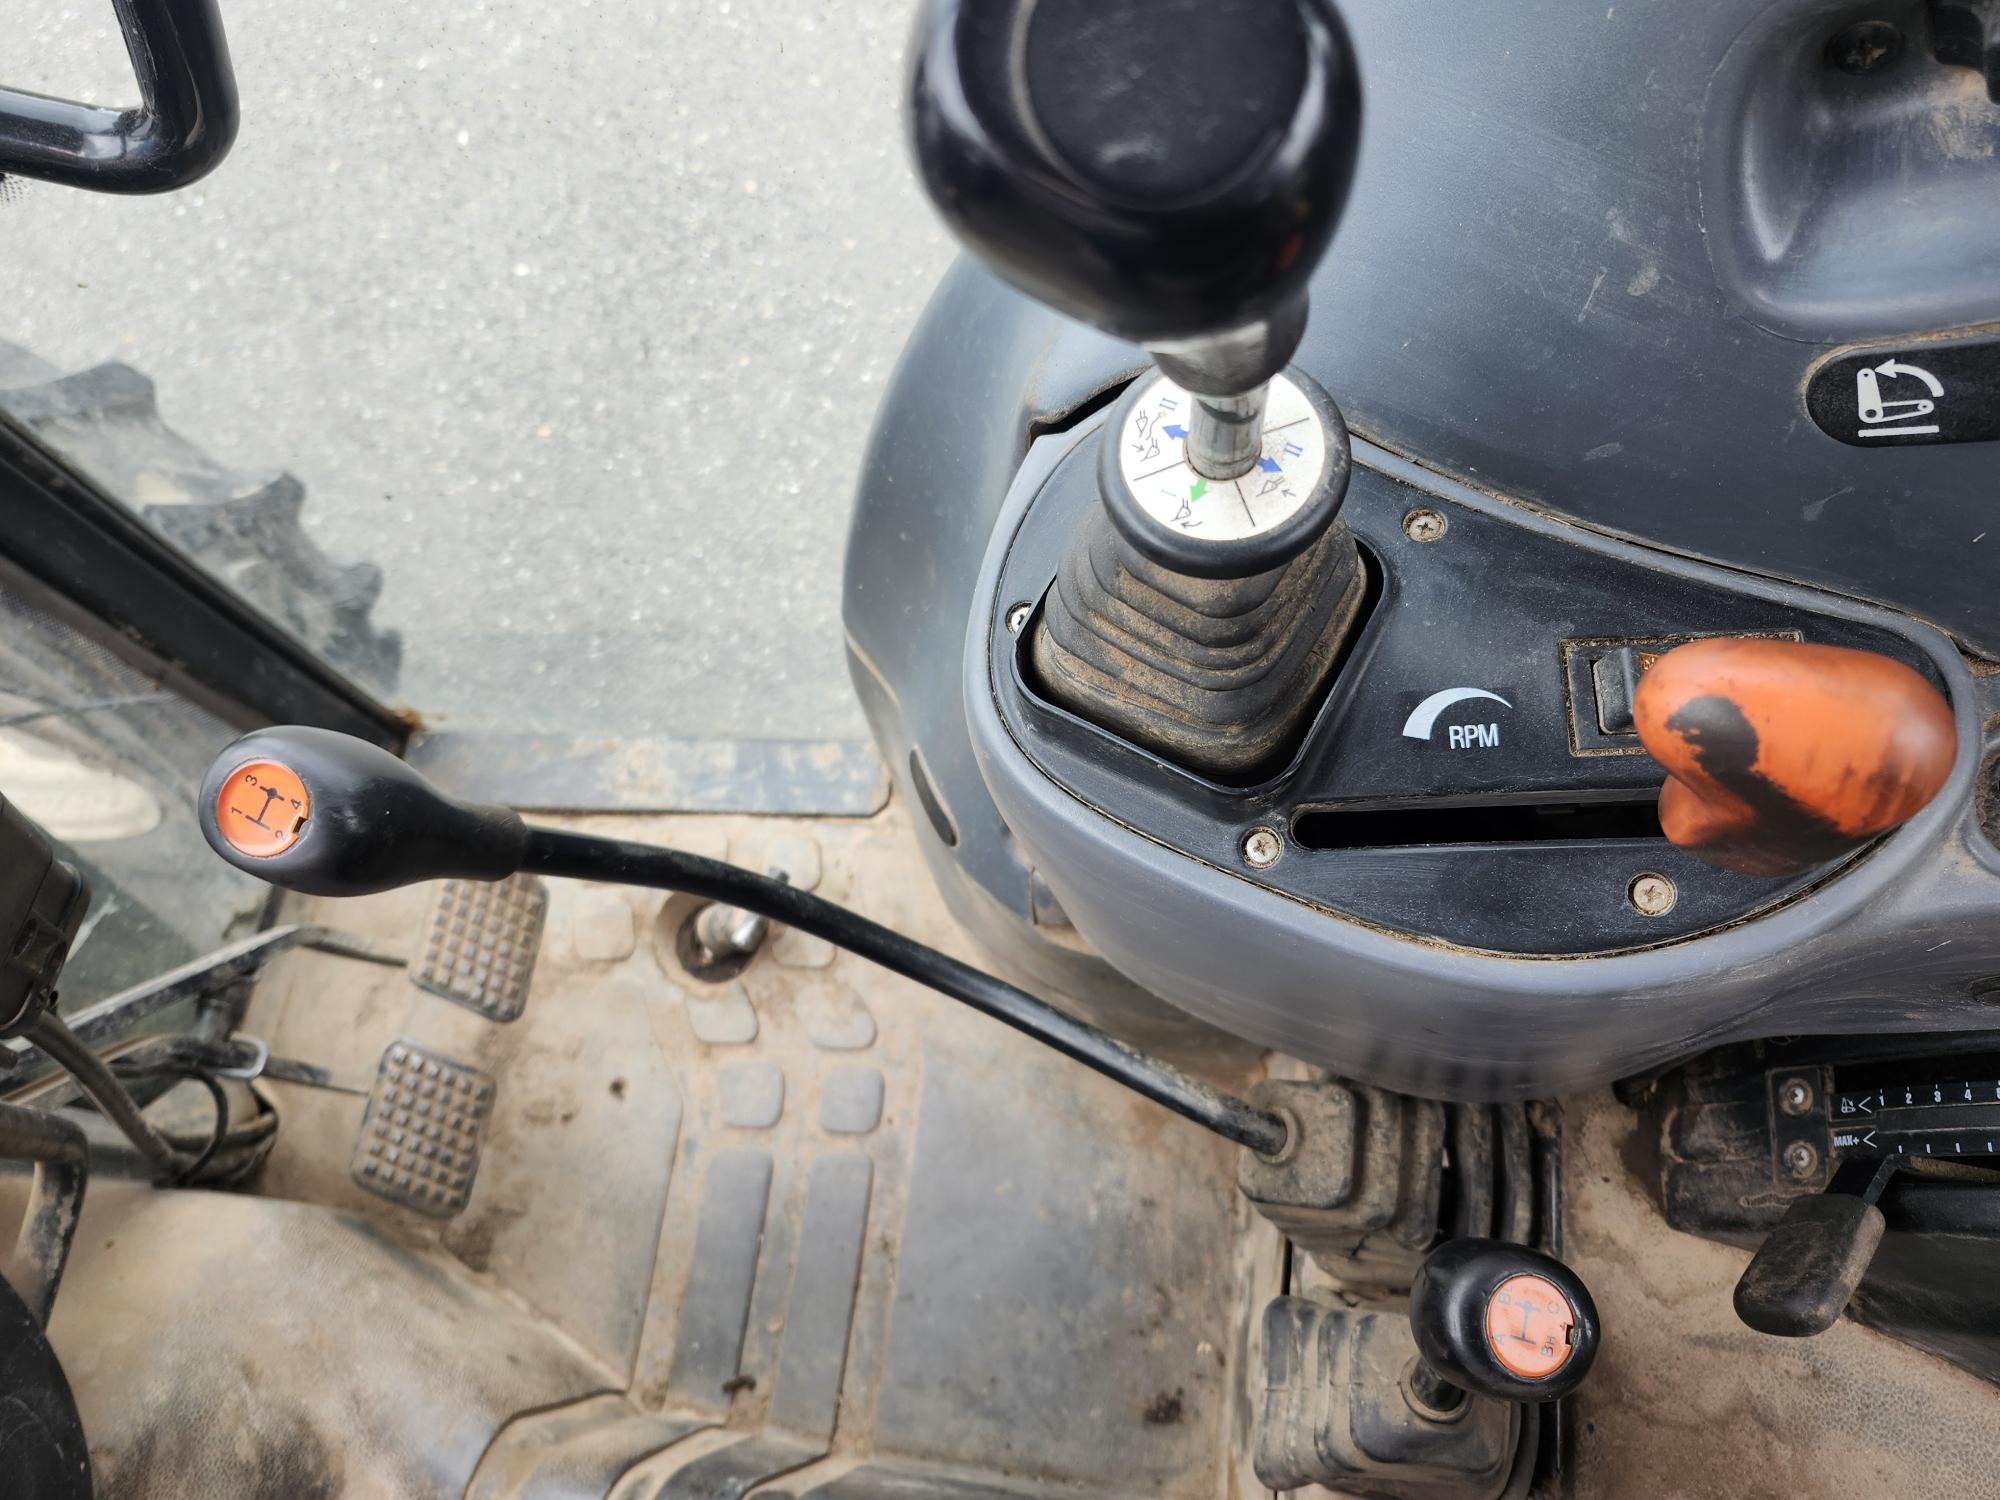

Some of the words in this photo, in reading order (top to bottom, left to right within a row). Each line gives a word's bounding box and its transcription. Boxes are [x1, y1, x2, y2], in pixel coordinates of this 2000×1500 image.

[1449, 723, 1499, 750] RPM
[245, 775, 258, 786] 3
[290, 799, 302, 810] 4
[1879, 1095, 1885, 1106] 1
[1905, 1092, 1913, 1104] 2
[1934, 1090, 1942, 1103] 3
[1965, 1089, 1972, 1101] 4
[1833, 1135, 1860, 1147] MAX+
[1547, 1300, 1559, 1313] C
